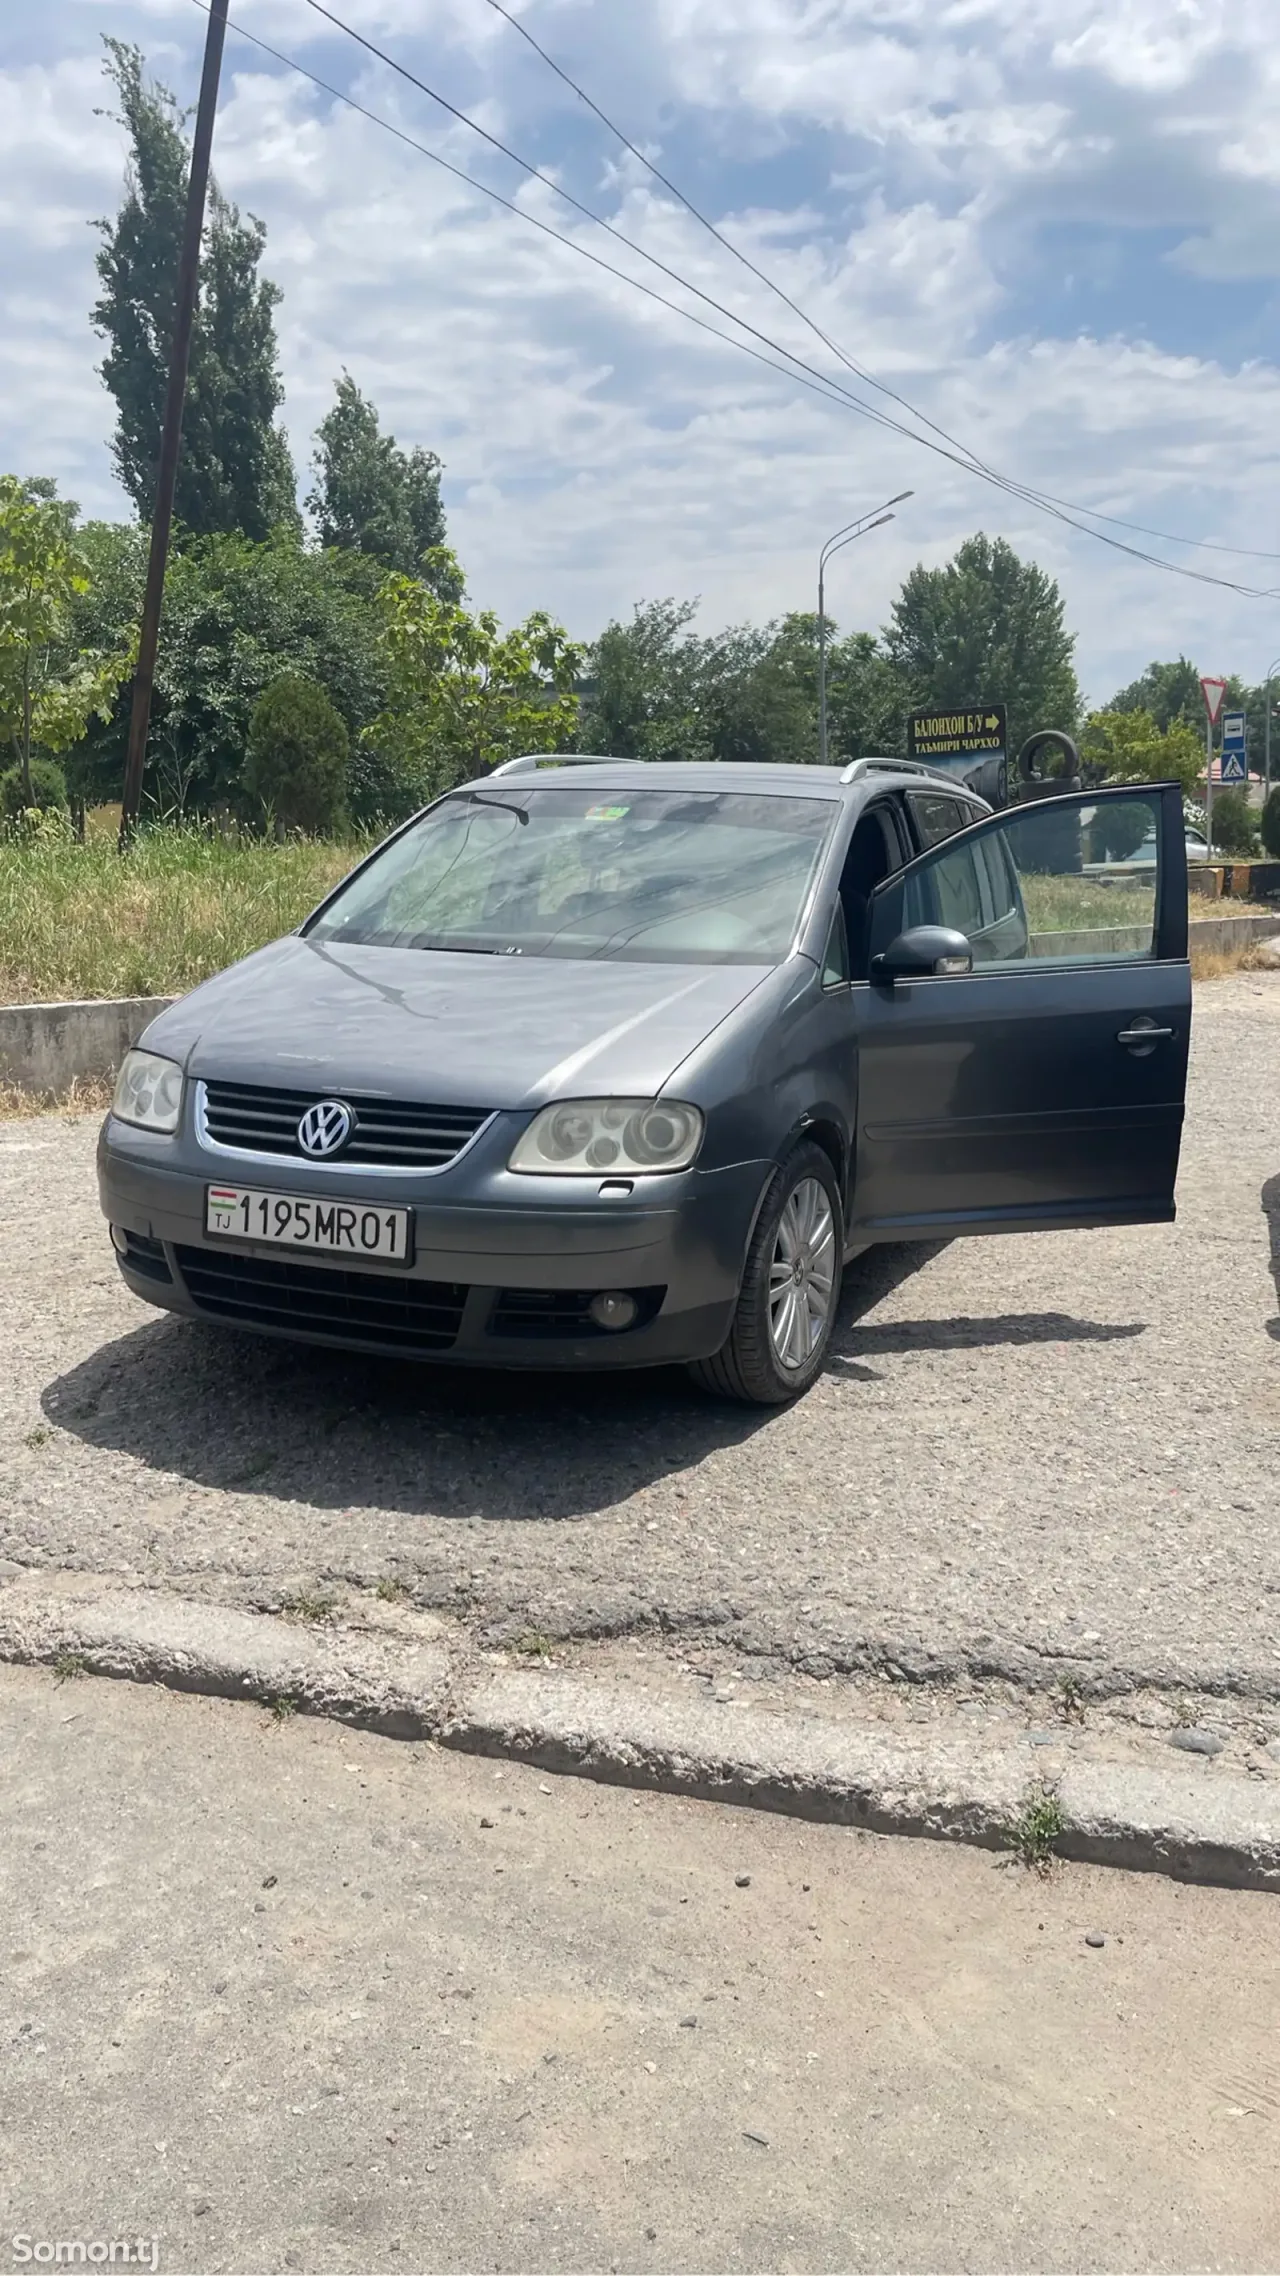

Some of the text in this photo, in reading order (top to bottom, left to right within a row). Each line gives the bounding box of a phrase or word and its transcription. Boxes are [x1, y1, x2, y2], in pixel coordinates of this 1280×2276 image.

[967, 714, 984, 735] Б/У
[915, 740, 960, 754] ТАЪМИРИ
[215, 1213, 230, 1229] TJ
[240, 1195, 396, 1252] 1195MR01
